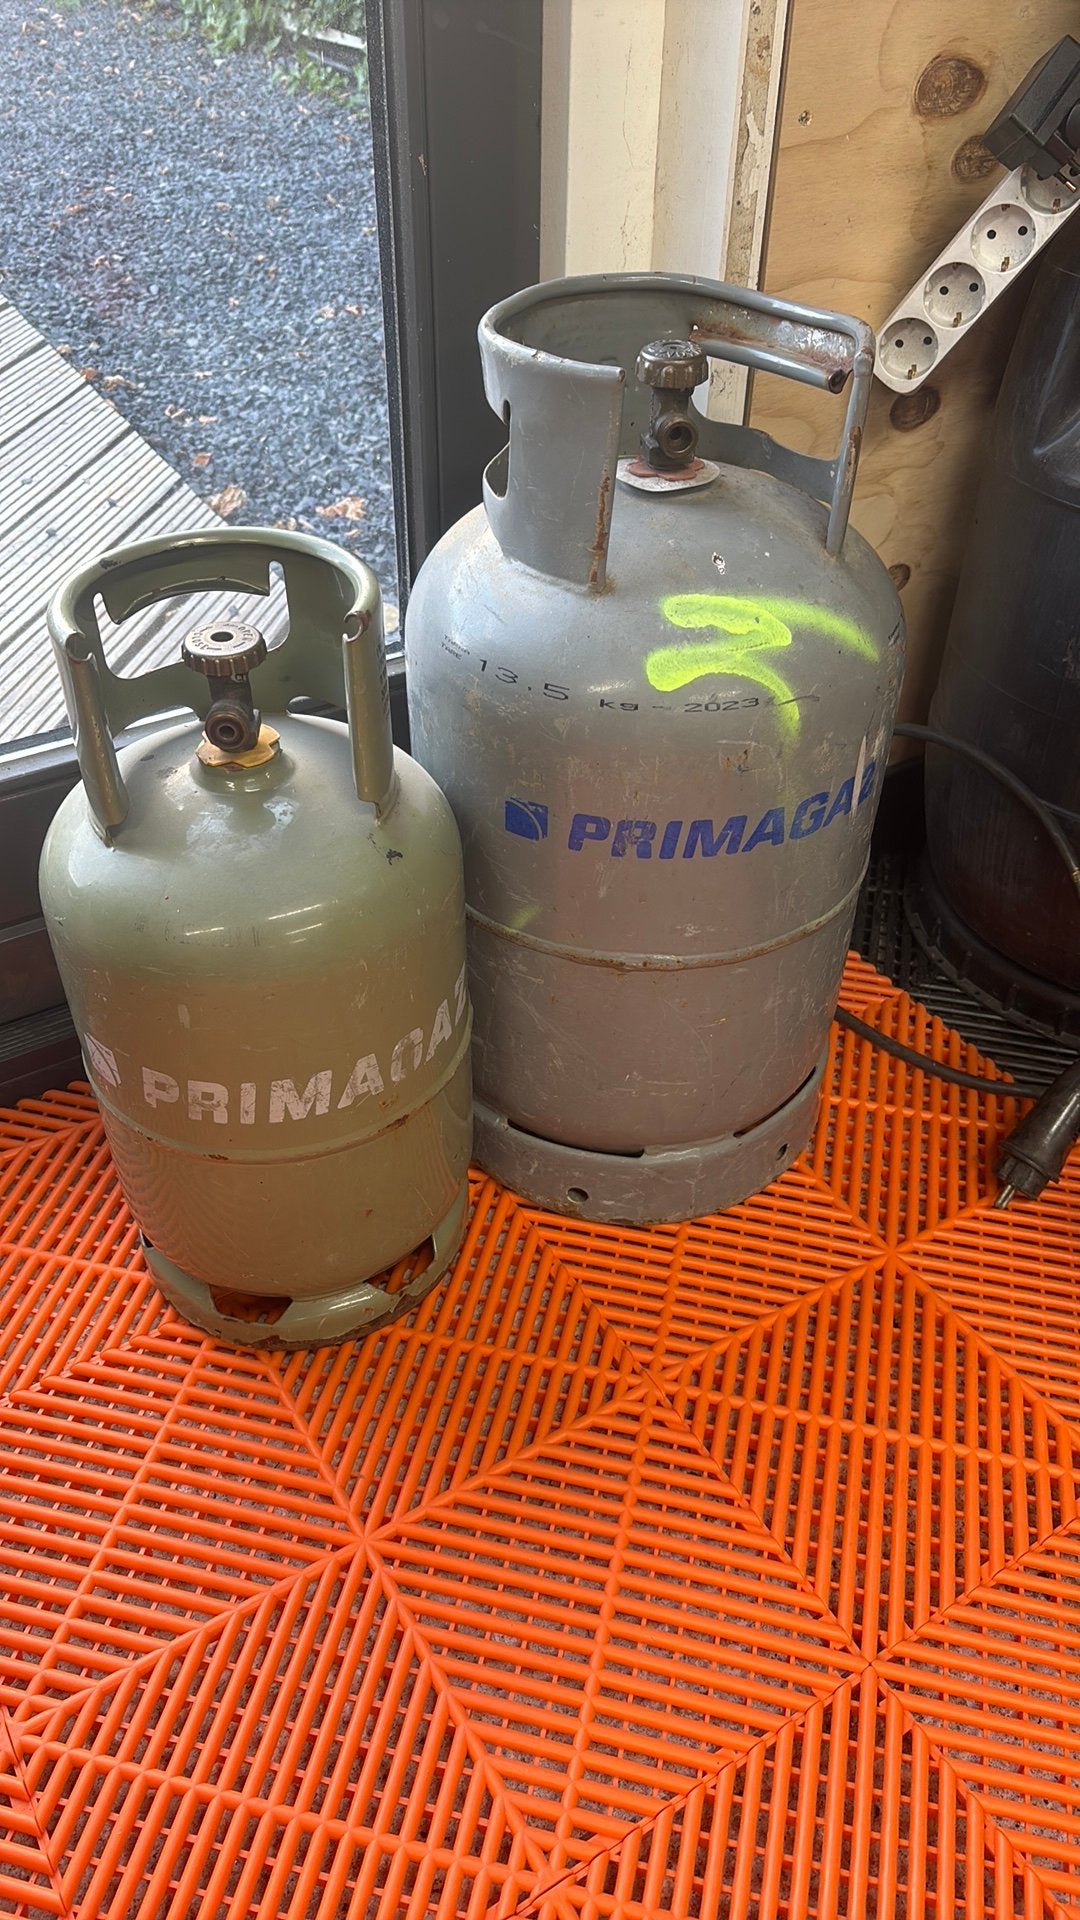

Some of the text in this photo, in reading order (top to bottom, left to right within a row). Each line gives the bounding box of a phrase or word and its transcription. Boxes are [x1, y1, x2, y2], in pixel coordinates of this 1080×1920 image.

[479, 658, 569, 701] 13.5
[600, 699, 639, 712] kg
[684, 697, 760, 713] 2023
